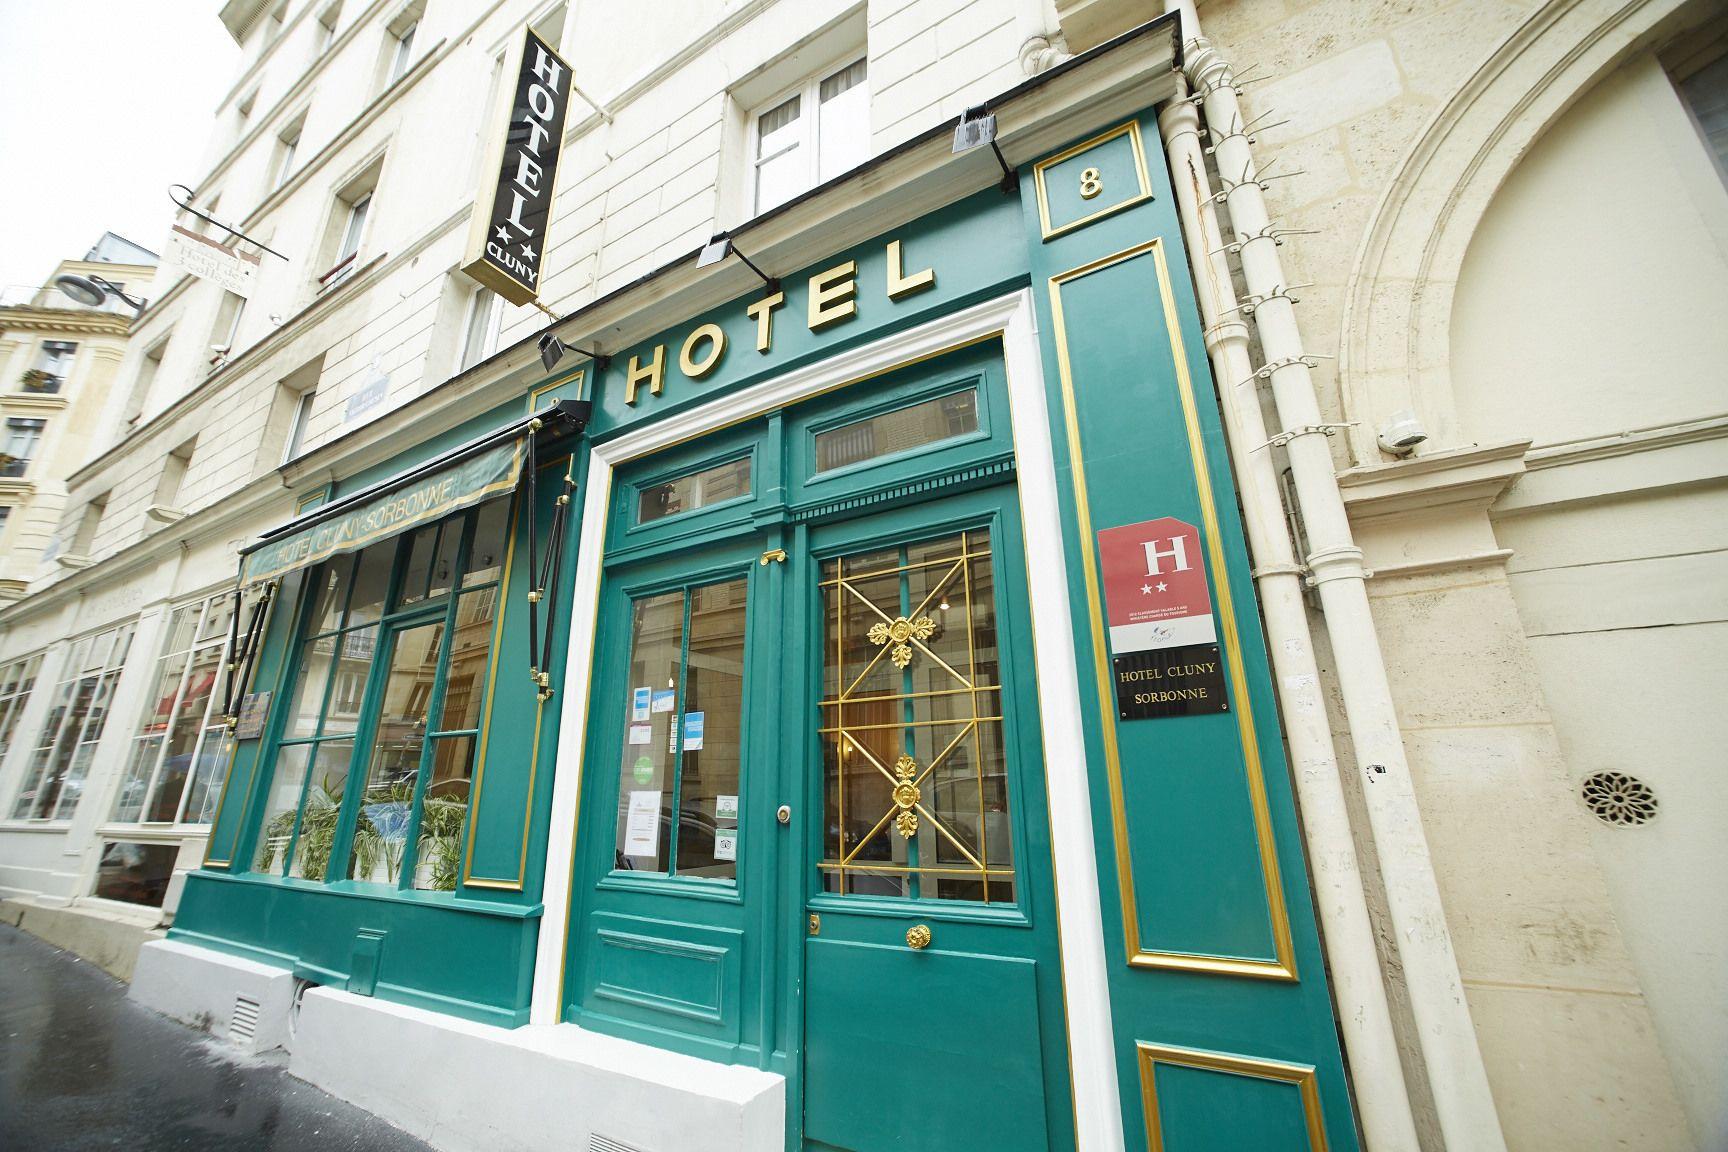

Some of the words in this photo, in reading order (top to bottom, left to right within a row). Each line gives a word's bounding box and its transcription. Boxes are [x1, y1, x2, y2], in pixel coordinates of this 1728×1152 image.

[505, 42, 563, 237] HOTEL
[1080, 167, 1103, 200] 8
[486, 241, 538, 283] CLUNY
[625, 239, 935, 407] HOTEL
[1140, 534, 1193, 577] H
[1120, 667, 1162, 683] HOTEL
[1167, 663, 1216, 677] CLUNY
[1135, 687, 1208, 704] SORBONNE
